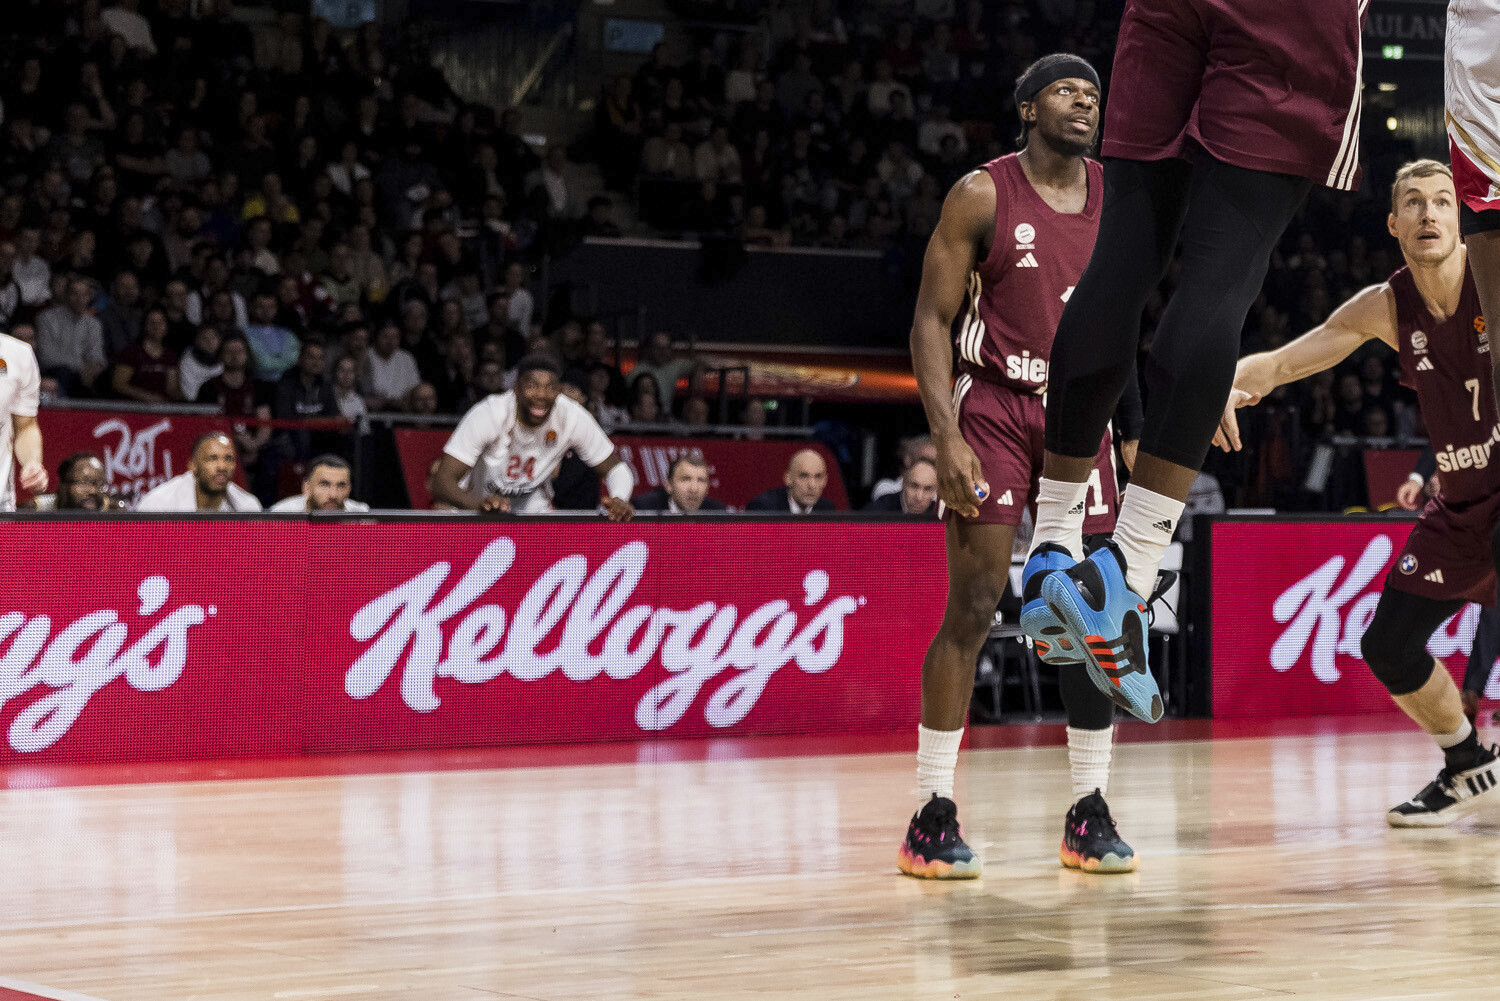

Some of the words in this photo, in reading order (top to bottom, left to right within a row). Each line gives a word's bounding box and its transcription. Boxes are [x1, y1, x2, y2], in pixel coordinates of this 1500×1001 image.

[1465, 378, 1481, 422] 7
[506, 455, 536, 481] 24
[344, 535, 862, 731] Kellogg's
